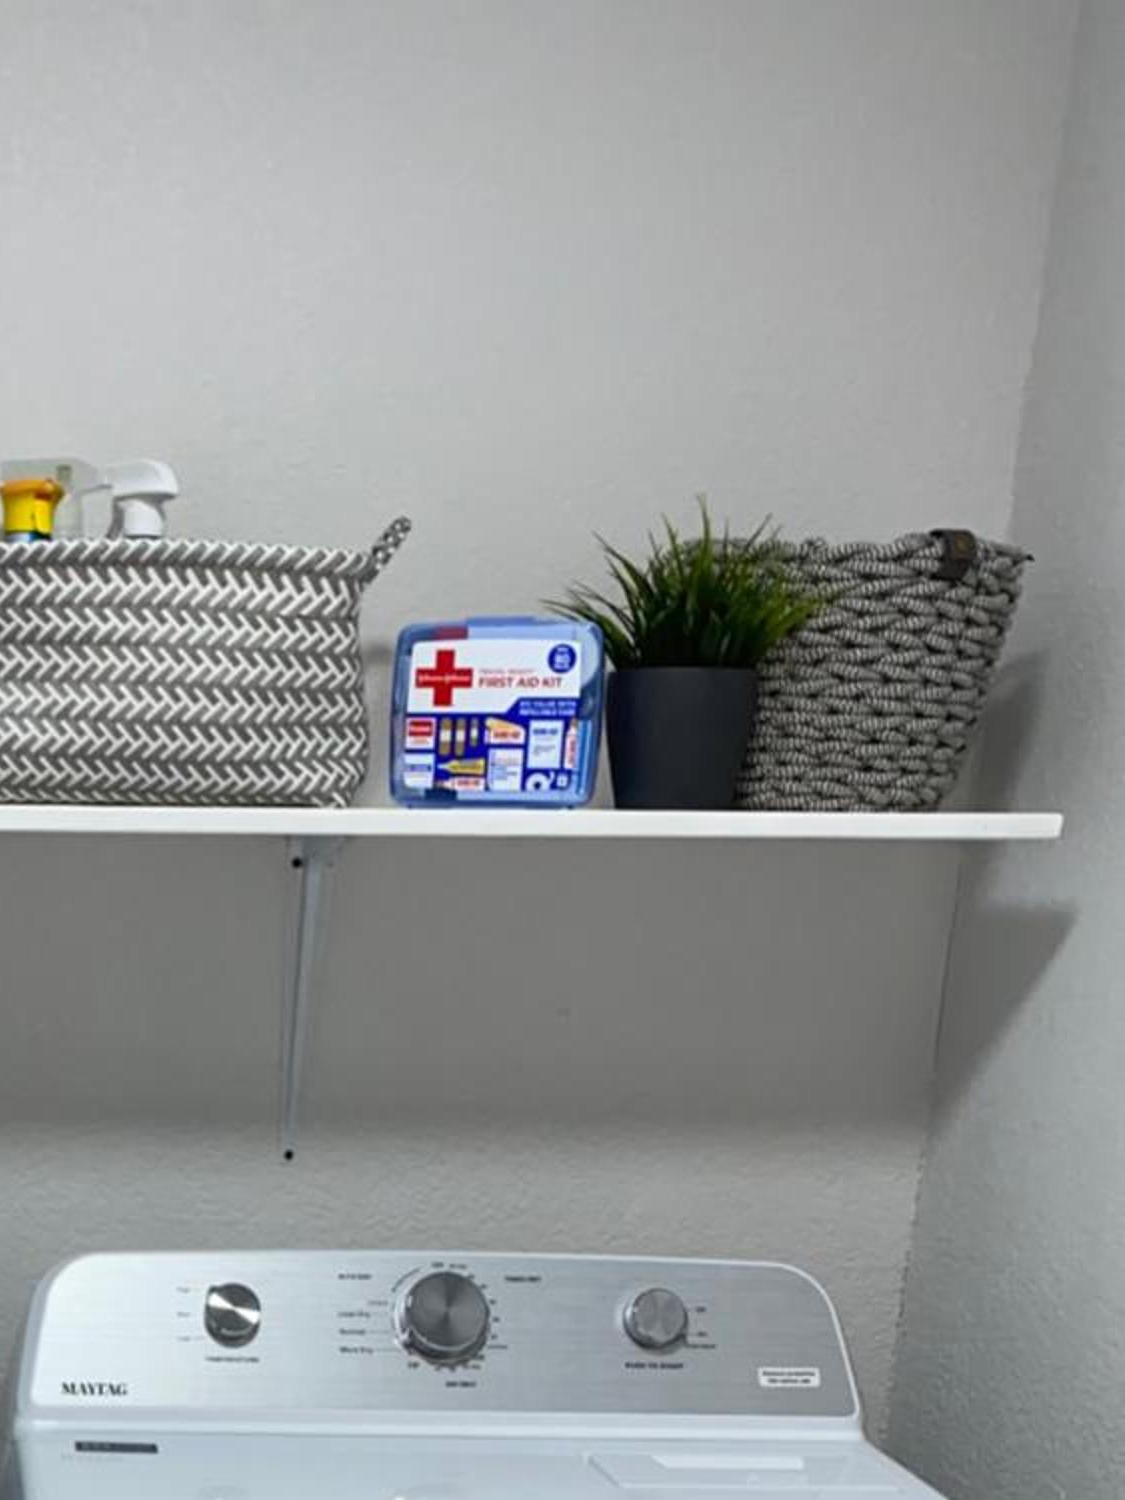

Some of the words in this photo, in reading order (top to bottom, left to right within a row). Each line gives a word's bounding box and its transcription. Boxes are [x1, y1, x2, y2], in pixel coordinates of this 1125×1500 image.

[478, 677, 514, 688] FIRST
[518, 677, 540, 688] AID
[542, 677, 563, 688] KIT
[61, 1382, 129, 1396] MAYTAG
